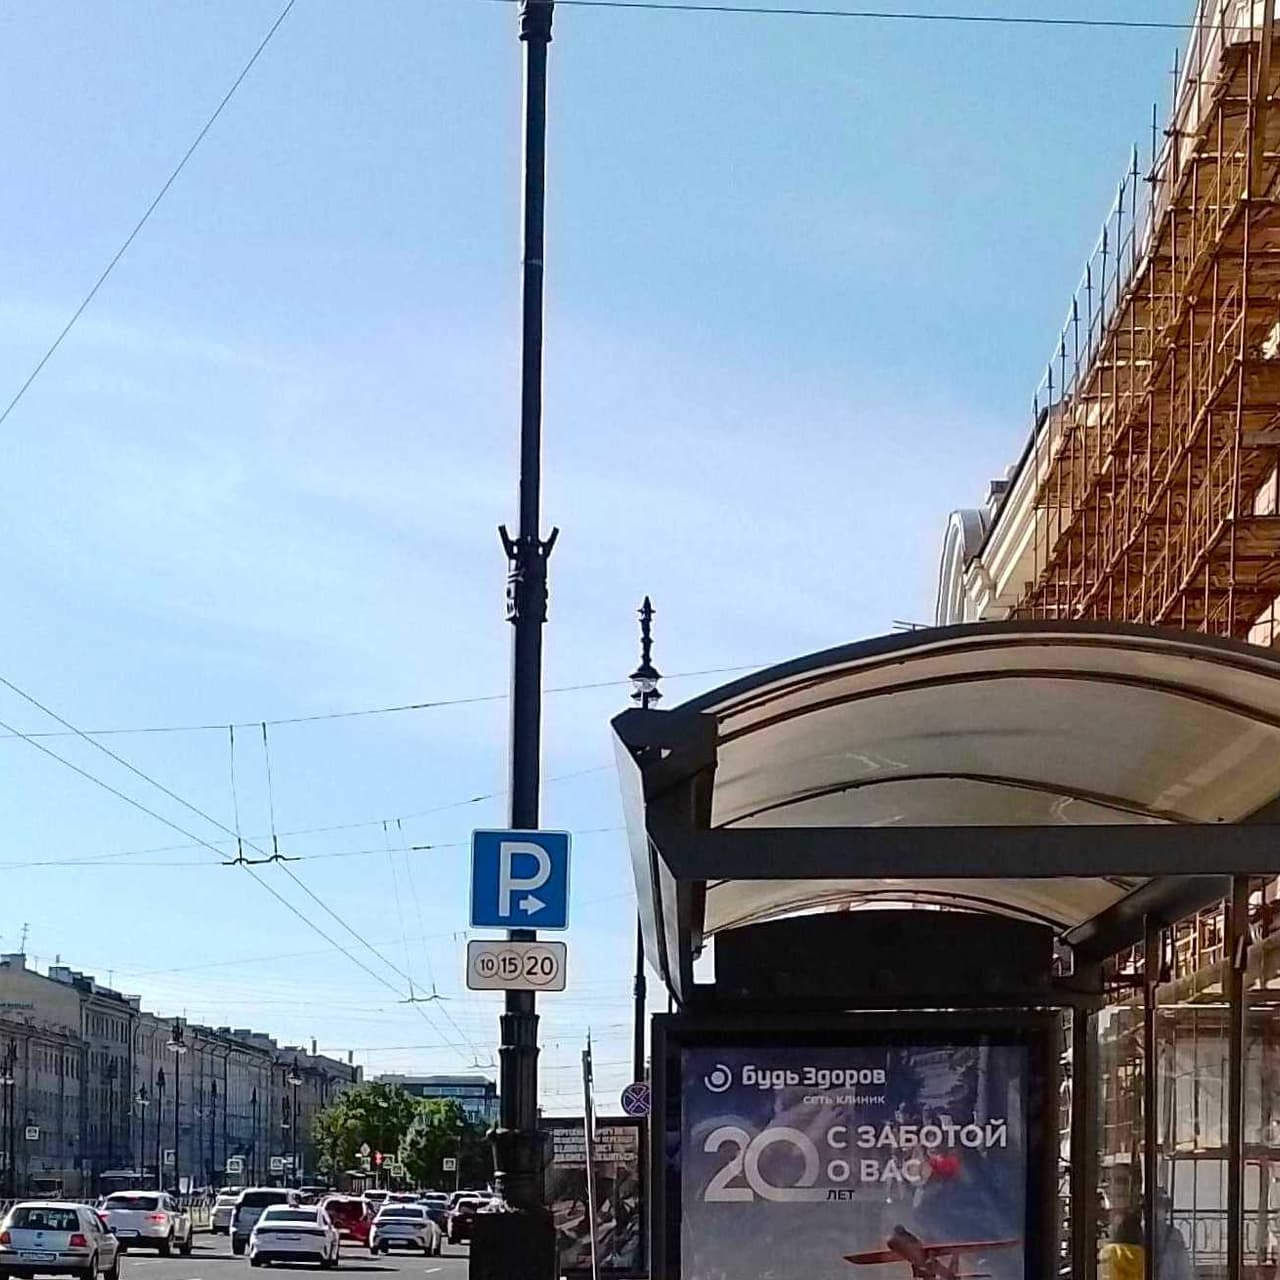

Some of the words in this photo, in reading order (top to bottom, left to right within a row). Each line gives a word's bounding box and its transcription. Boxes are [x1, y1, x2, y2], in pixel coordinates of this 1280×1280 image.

[498, 841, 552, 917] P
[480, 958, 495, 972] 10
[500, 956, 518, 974] 15
[525, 956, 554, 976] 20
[803, 1095, 833, 1105] сеть
[836, 1095, 885, 1105] клиник
[827, 1126, 847, 1149] С
[857, 1118, 1007, 1149] ЗАБОТОЙ
[704, 1126, 820, 1202] 20
[827, 1159, 850, 1182] О
[860, 1159, 924, 1182] ВАС
[826, 1190, 855, 1201] ЛЕТ
